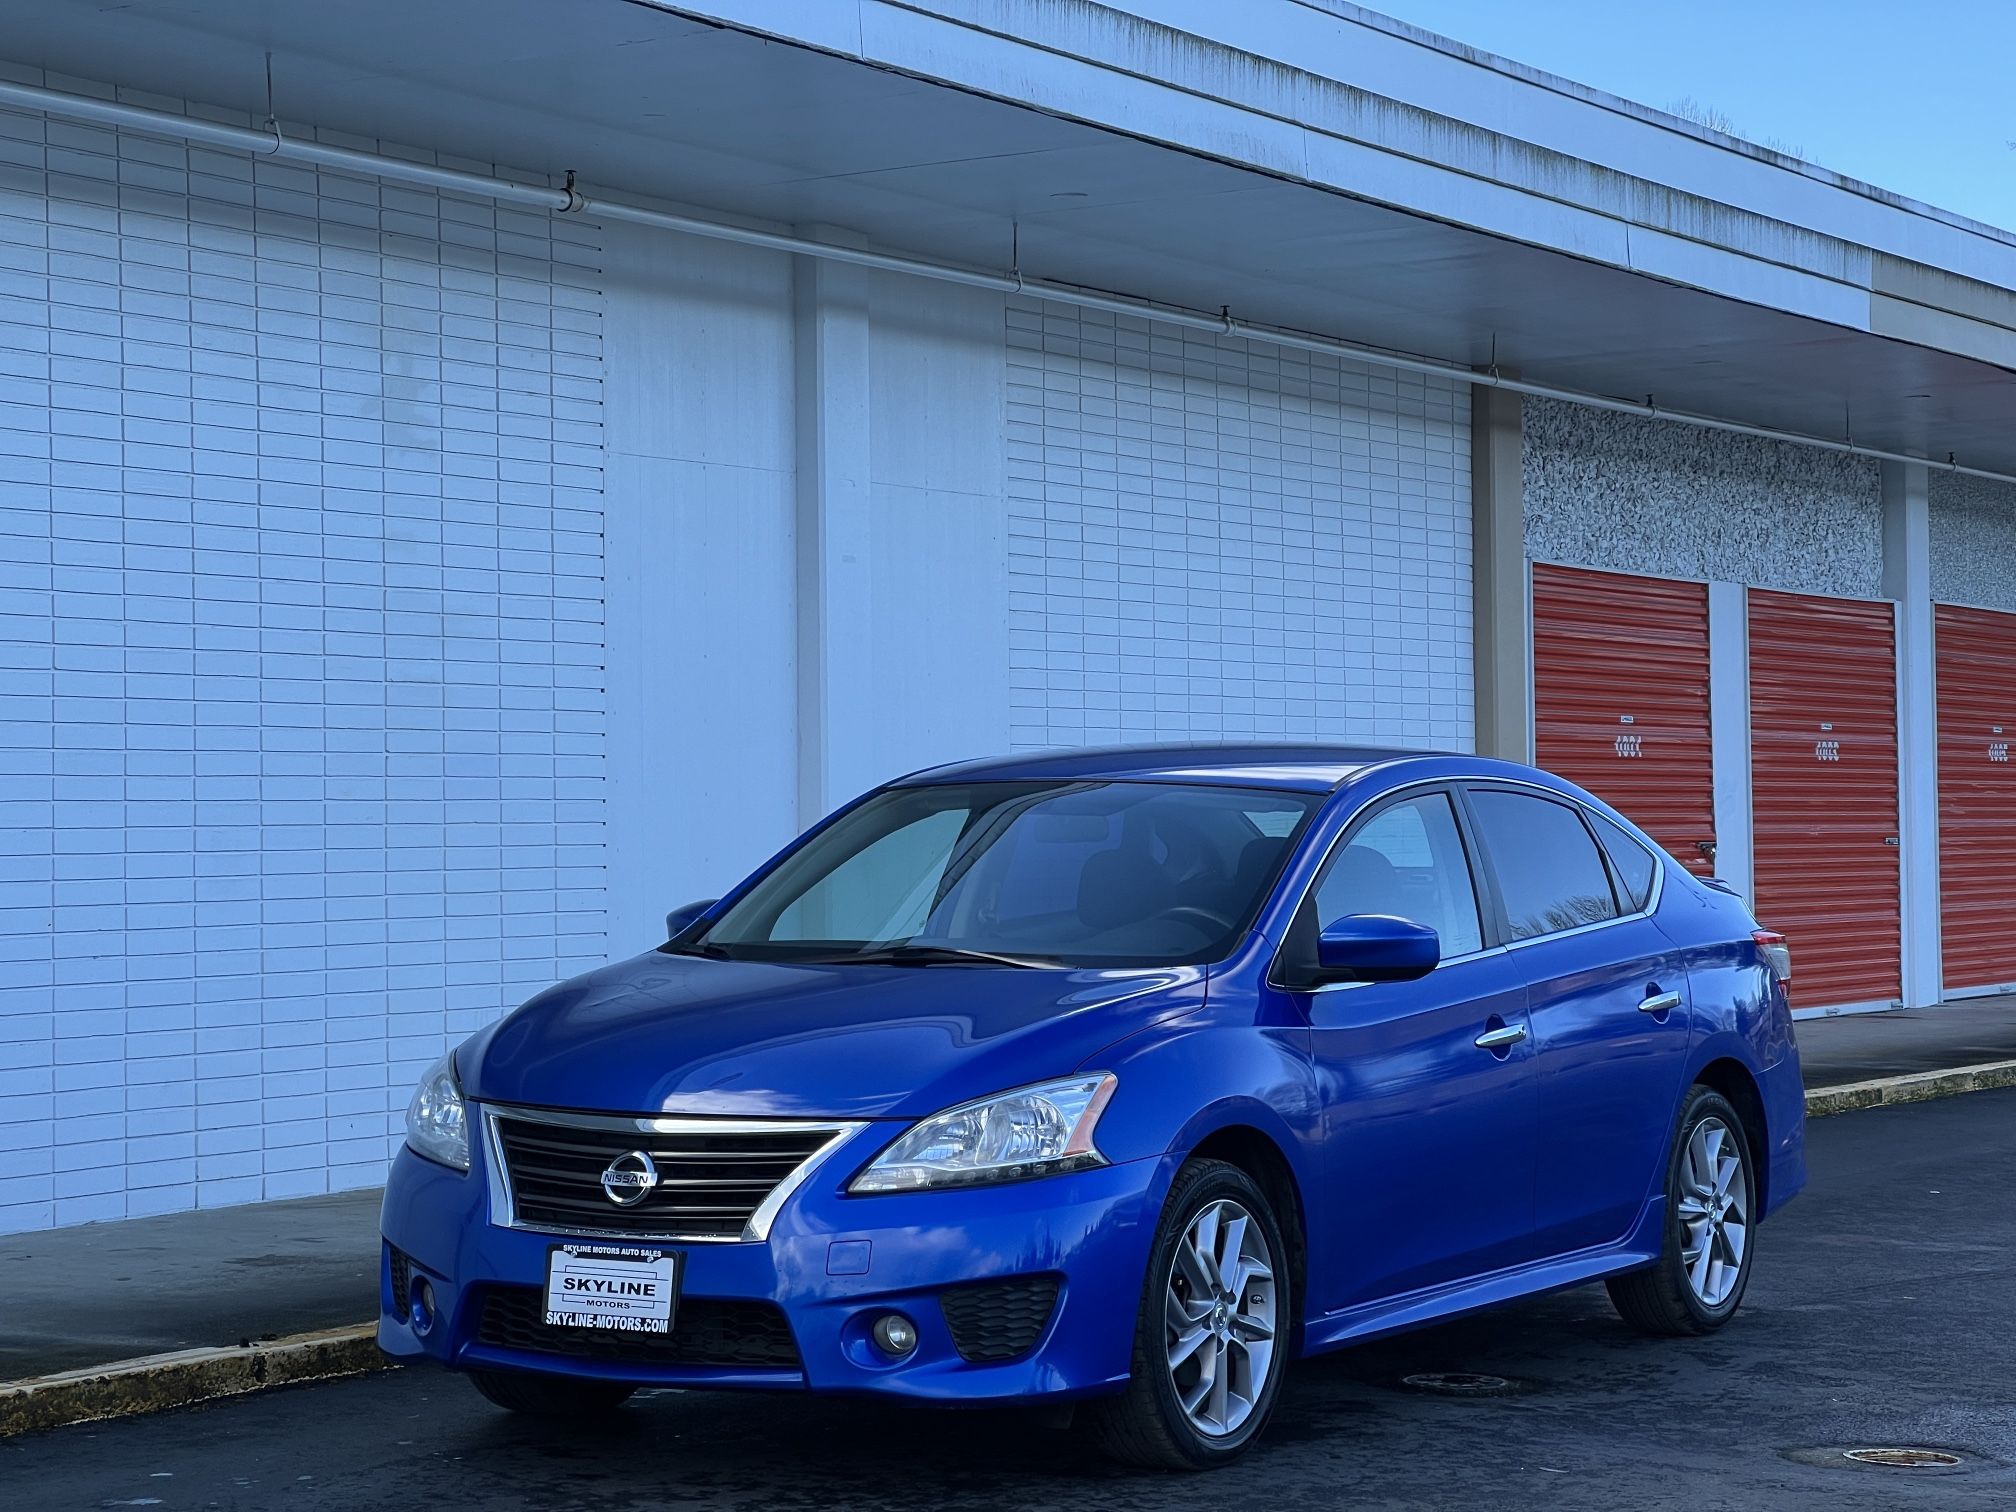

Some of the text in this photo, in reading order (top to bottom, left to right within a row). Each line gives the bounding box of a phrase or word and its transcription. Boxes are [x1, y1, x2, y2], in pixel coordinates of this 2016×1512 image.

[604, 1173, 649, 1184] NISSAN
[563, 1244, 662, 1258] SKYLINE MOTORS AUTO SALES
[563, 1277, 656, 1297] SKYLINE
[586, 1299, 631, 1310] MOTORS
[545, 1311, 669, 1333] SKYLINE-MOTORS.COM
